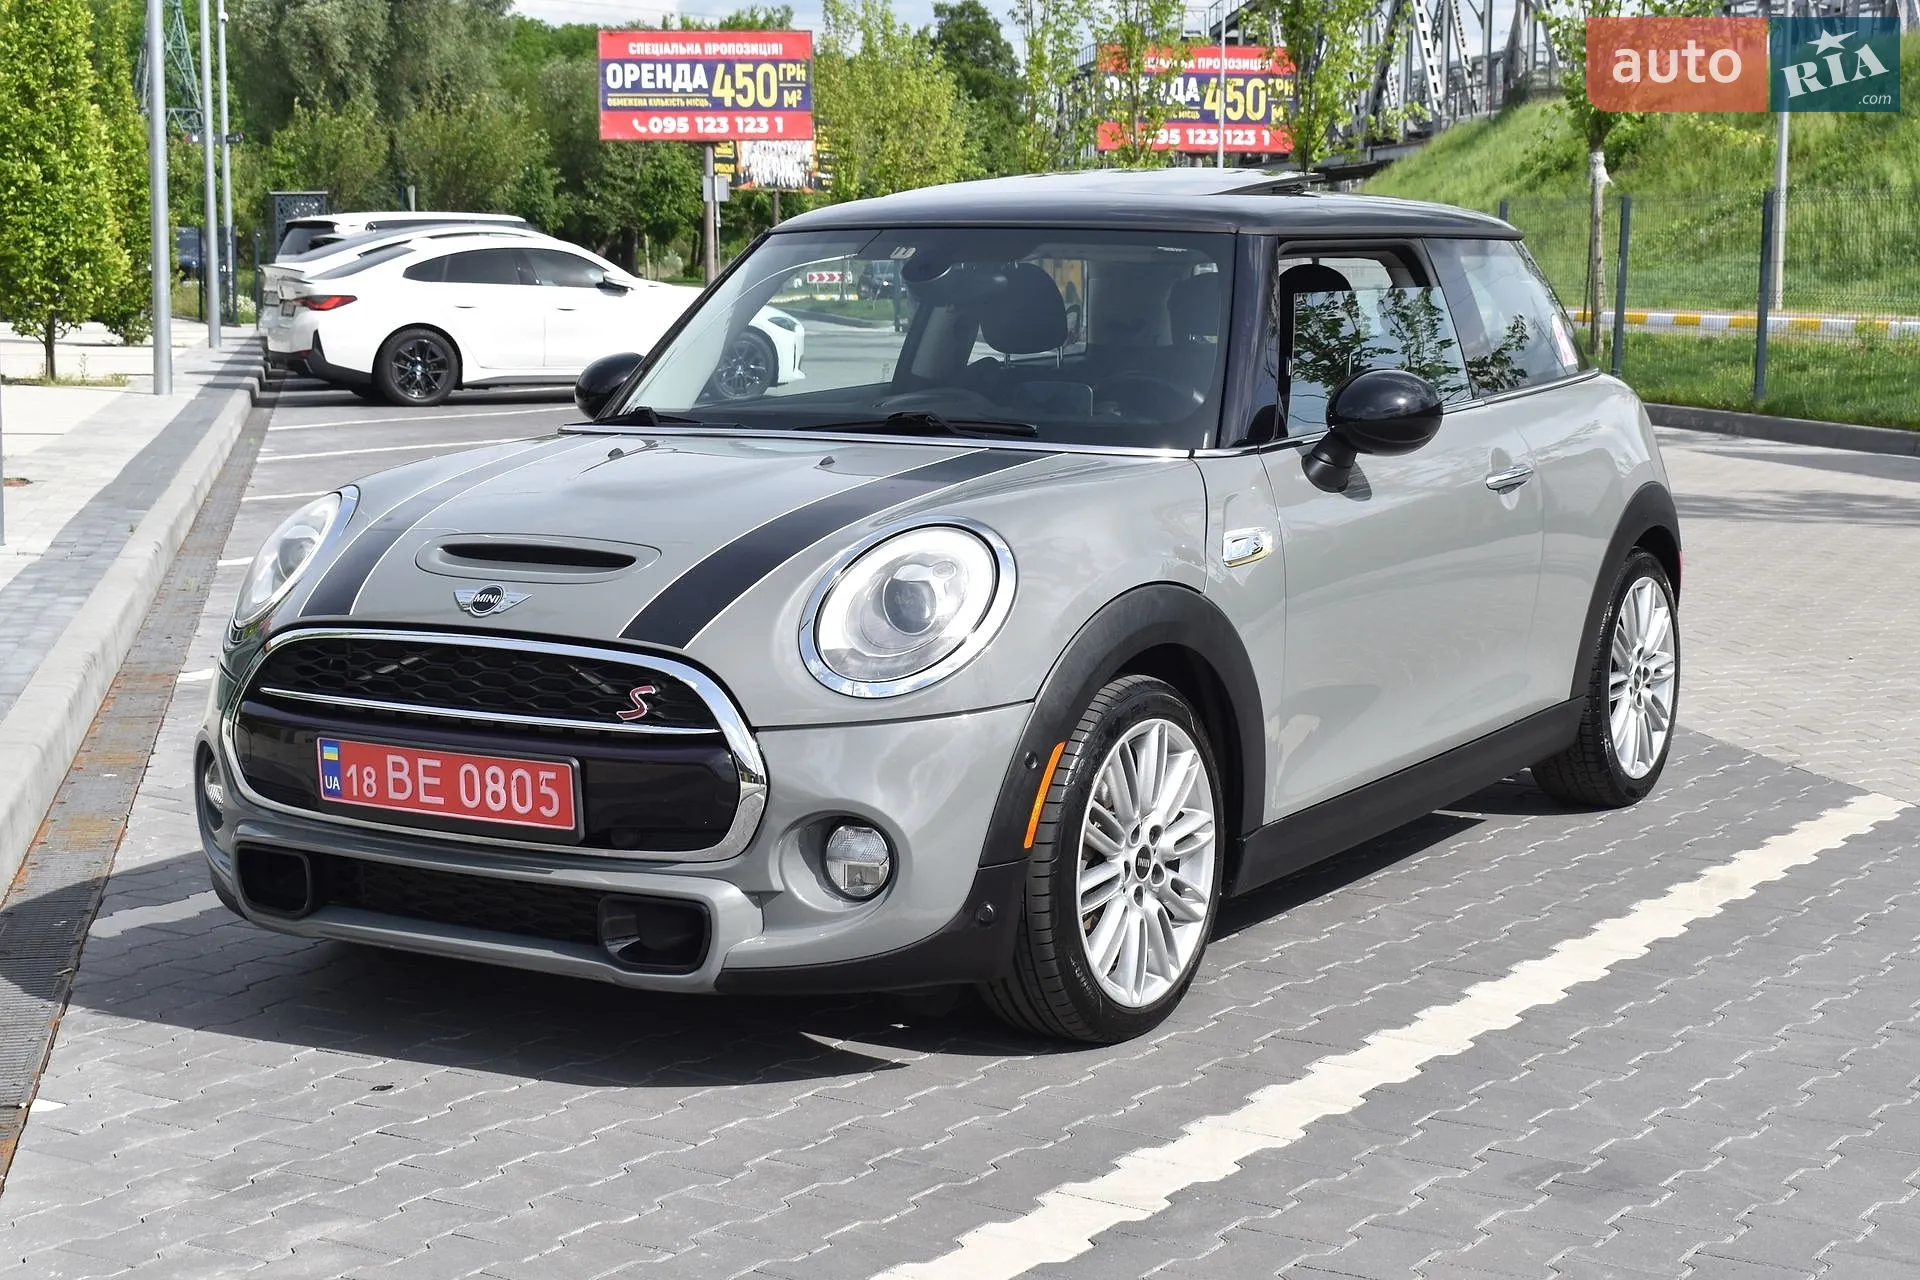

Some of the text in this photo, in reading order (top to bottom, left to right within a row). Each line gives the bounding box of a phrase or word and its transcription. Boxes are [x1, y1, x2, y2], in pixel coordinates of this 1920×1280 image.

[628, 42, 783, 56] СПЕЦІАЛЬНА ПРОПОЗИЦІЯ!
[606, 63, 806, 108] ОРЕНДА 450 ГРН
[1203, 77, 1266, 121] 450
[648, 116, 784, 134] 095 123 123 1
[1186, 128, 1219, 145] 123
[1224, 129, 1256, 145] 123
[1261, 129, 1271, 146] 1
[474, 593, 500, 604] MINI
[616, 685, 657, 721] S
[324, 775, 341, 791] UA
[346, 754, 560, 818] 18 BE 0805
